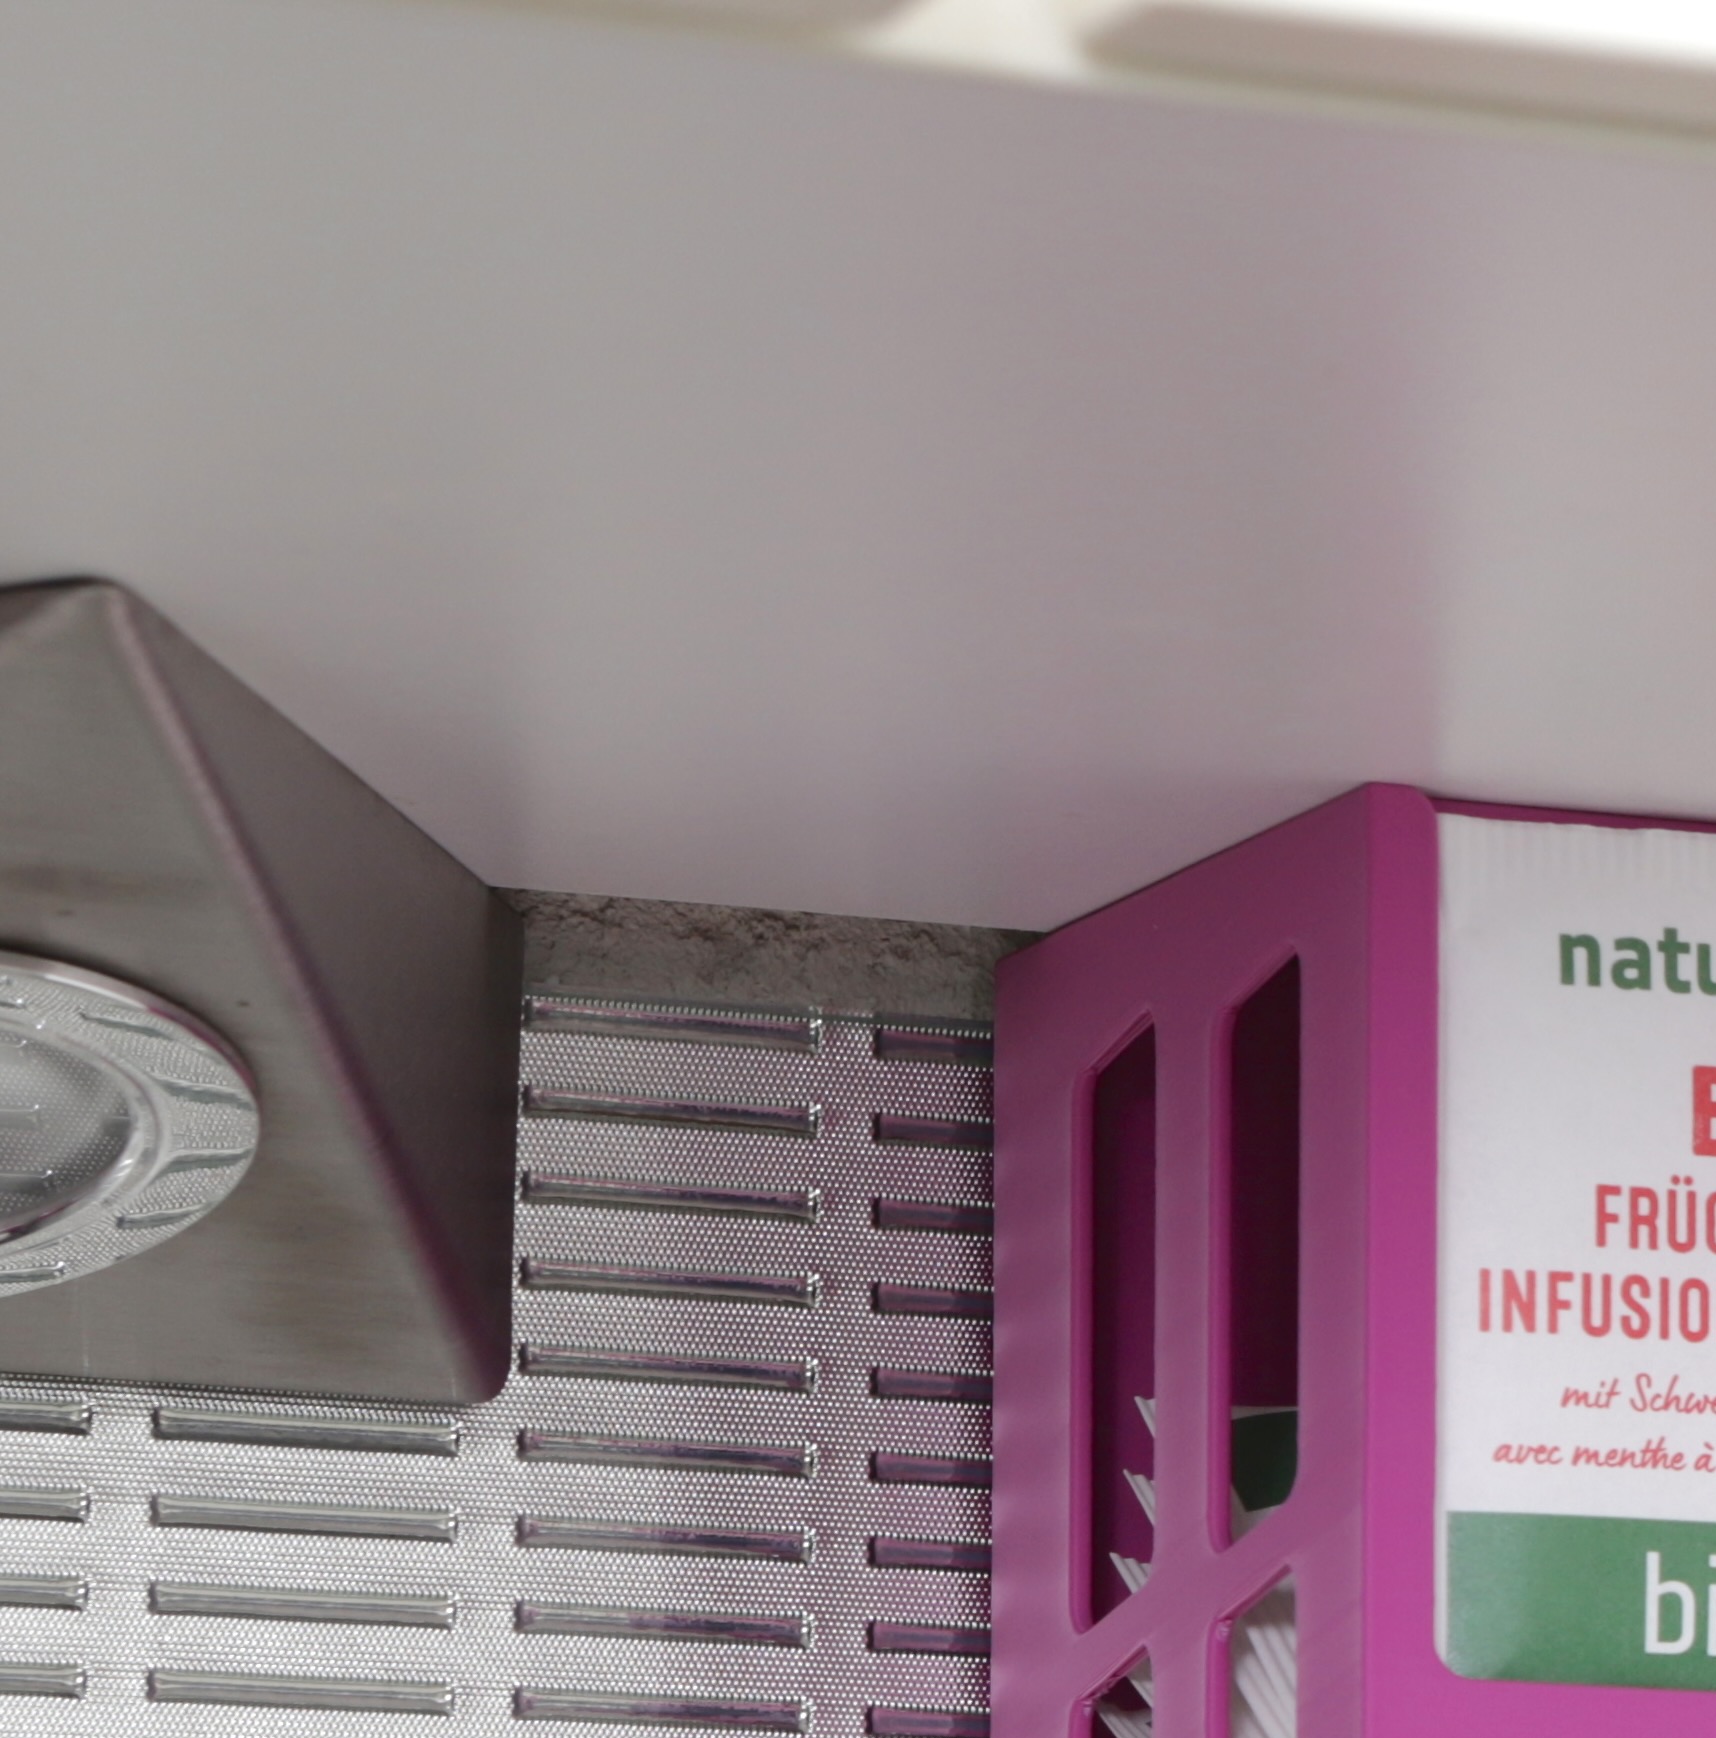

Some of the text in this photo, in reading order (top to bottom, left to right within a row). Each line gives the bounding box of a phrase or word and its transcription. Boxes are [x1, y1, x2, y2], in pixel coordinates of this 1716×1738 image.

[1559, 1377, 1622, 1409] mit
[1491, 1442, 1563, 1466] avec
[1570, 1436, 1687, 1470] menthe
[1692, 1441, 1716, 1473] à
